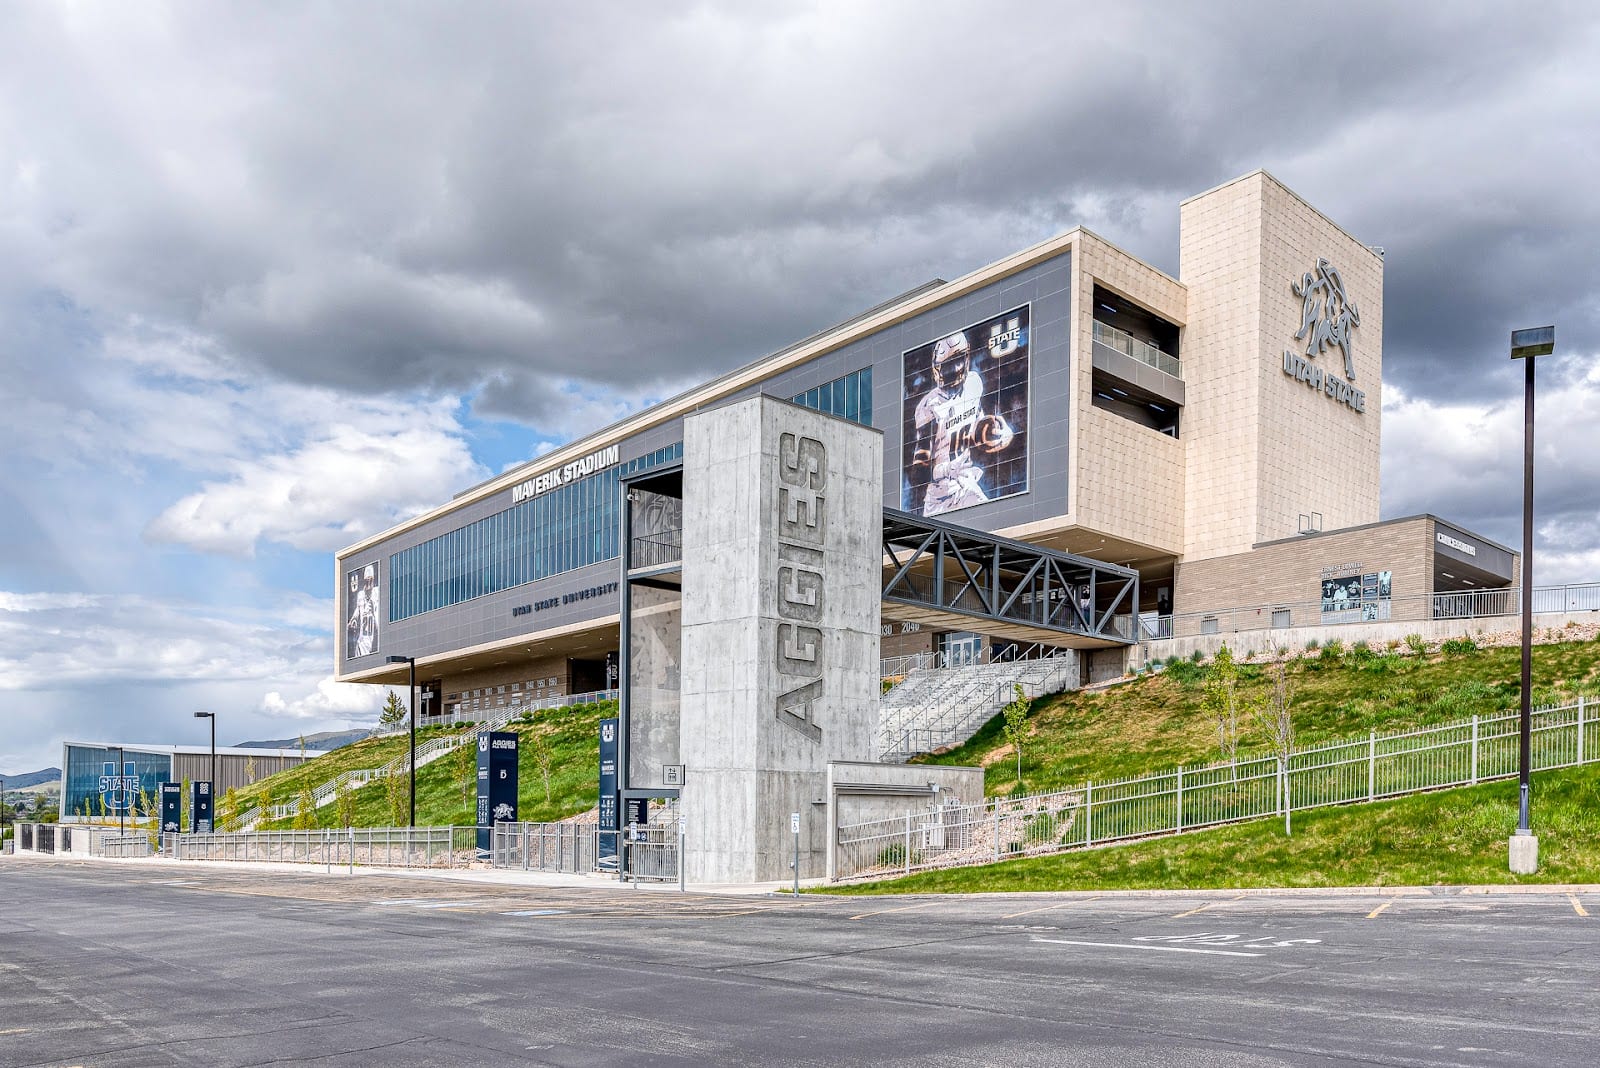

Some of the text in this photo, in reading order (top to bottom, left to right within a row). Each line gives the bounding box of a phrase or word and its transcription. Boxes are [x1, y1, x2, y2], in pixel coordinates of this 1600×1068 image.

[988, 327, 1020, 349] STATE
[1283, 349, 1366, 413] UTAH STATE
[945, 414, 962, 430] UTAH
[512, 444, 620, 503] MAVERIK STADIUM
[512, 581, 619, 617] UTAH STATE UNIVERSITY
[776, 431, 826, 744] AGGIES
[99, 775, 140, 794] STATE
